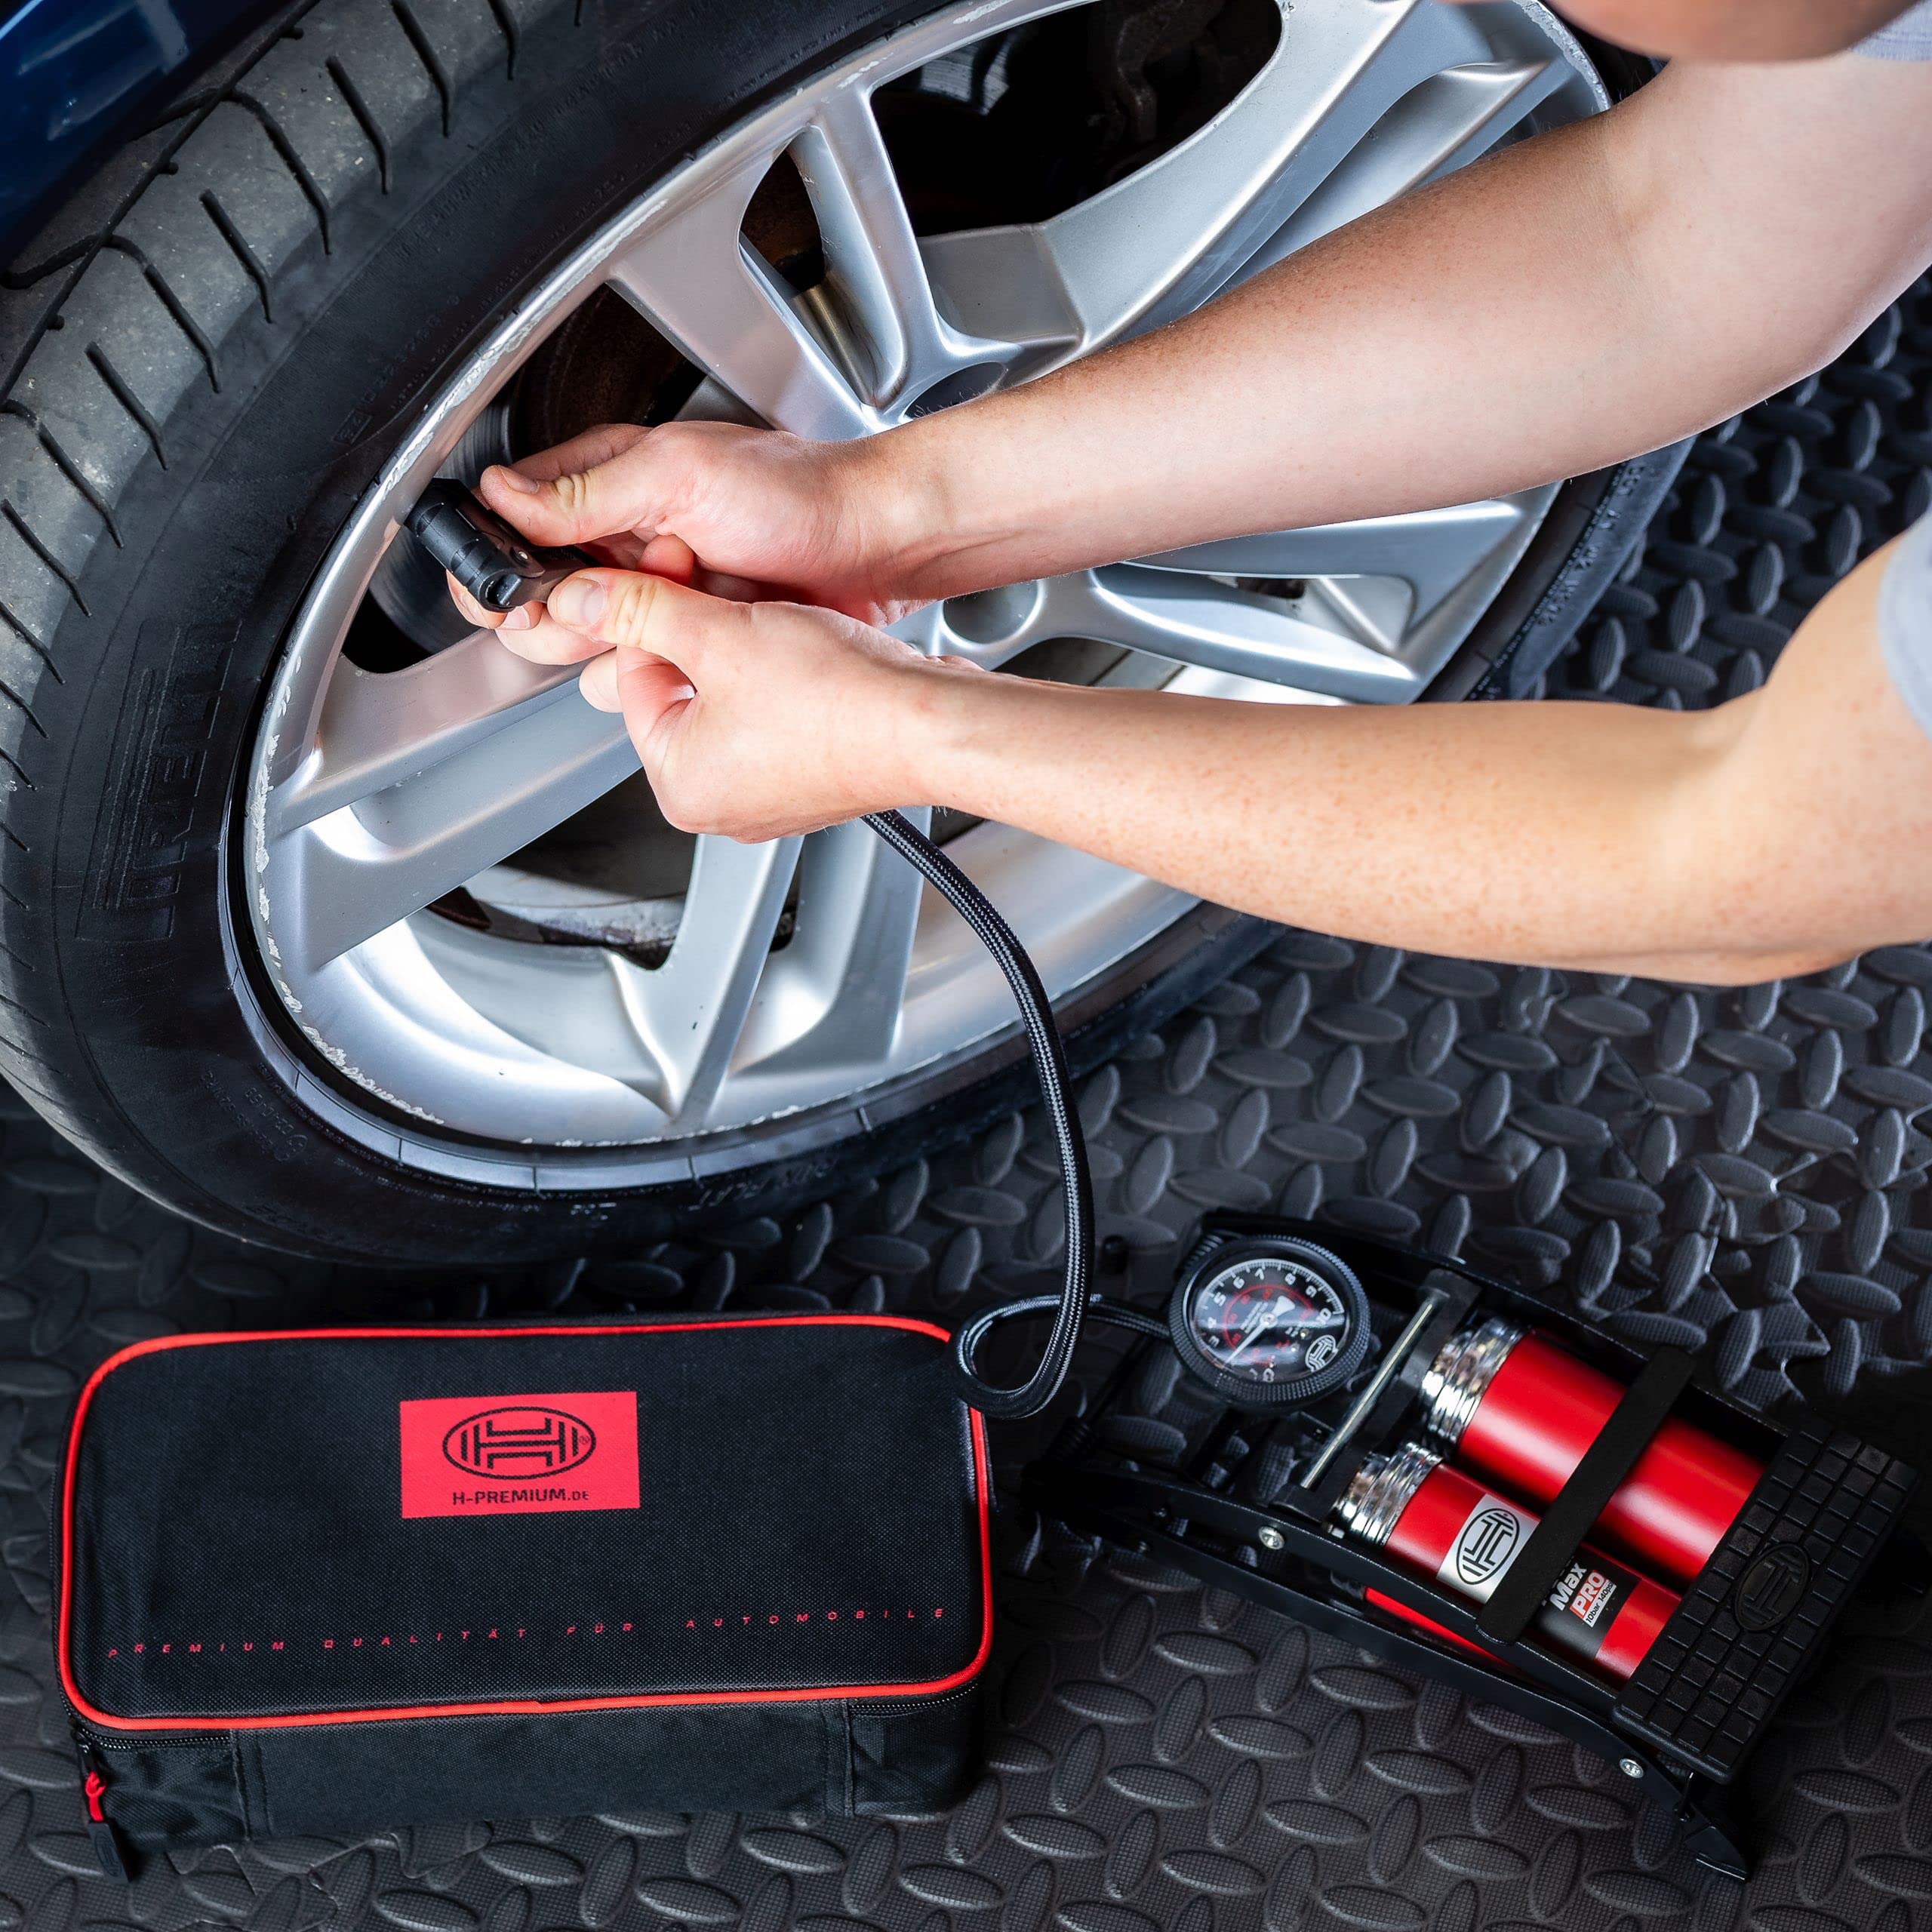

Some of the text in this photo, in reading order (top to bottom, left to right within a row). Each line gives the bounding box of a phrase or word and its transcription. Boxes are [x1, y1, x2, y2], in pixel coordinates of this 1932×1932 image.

[1233, 1275, 1244, 1289] 6
[1254, 1268, 1265, 1281] 7
[1284, 1272, 1297, 1285] 8
[1214, 1291, 1226, 1307] 5
[1306, 1285, 1317, 1298] 9
[1315, 1308, 1332, 1324] 10
[1208, 1335, 1220, 1347] 3
[452, 1487, 590, 1506] H-PREMIUM.DE
[1549, 1562, 1587, 1611] Max
[1572, 1572, 1605, 1616] PRO
[1586, 1581, 1614, 1623] 10bar 140psi
[108, 1607, 943, 1657] PREMIUM QUALITÄT FÜR AUTOMOBILE
